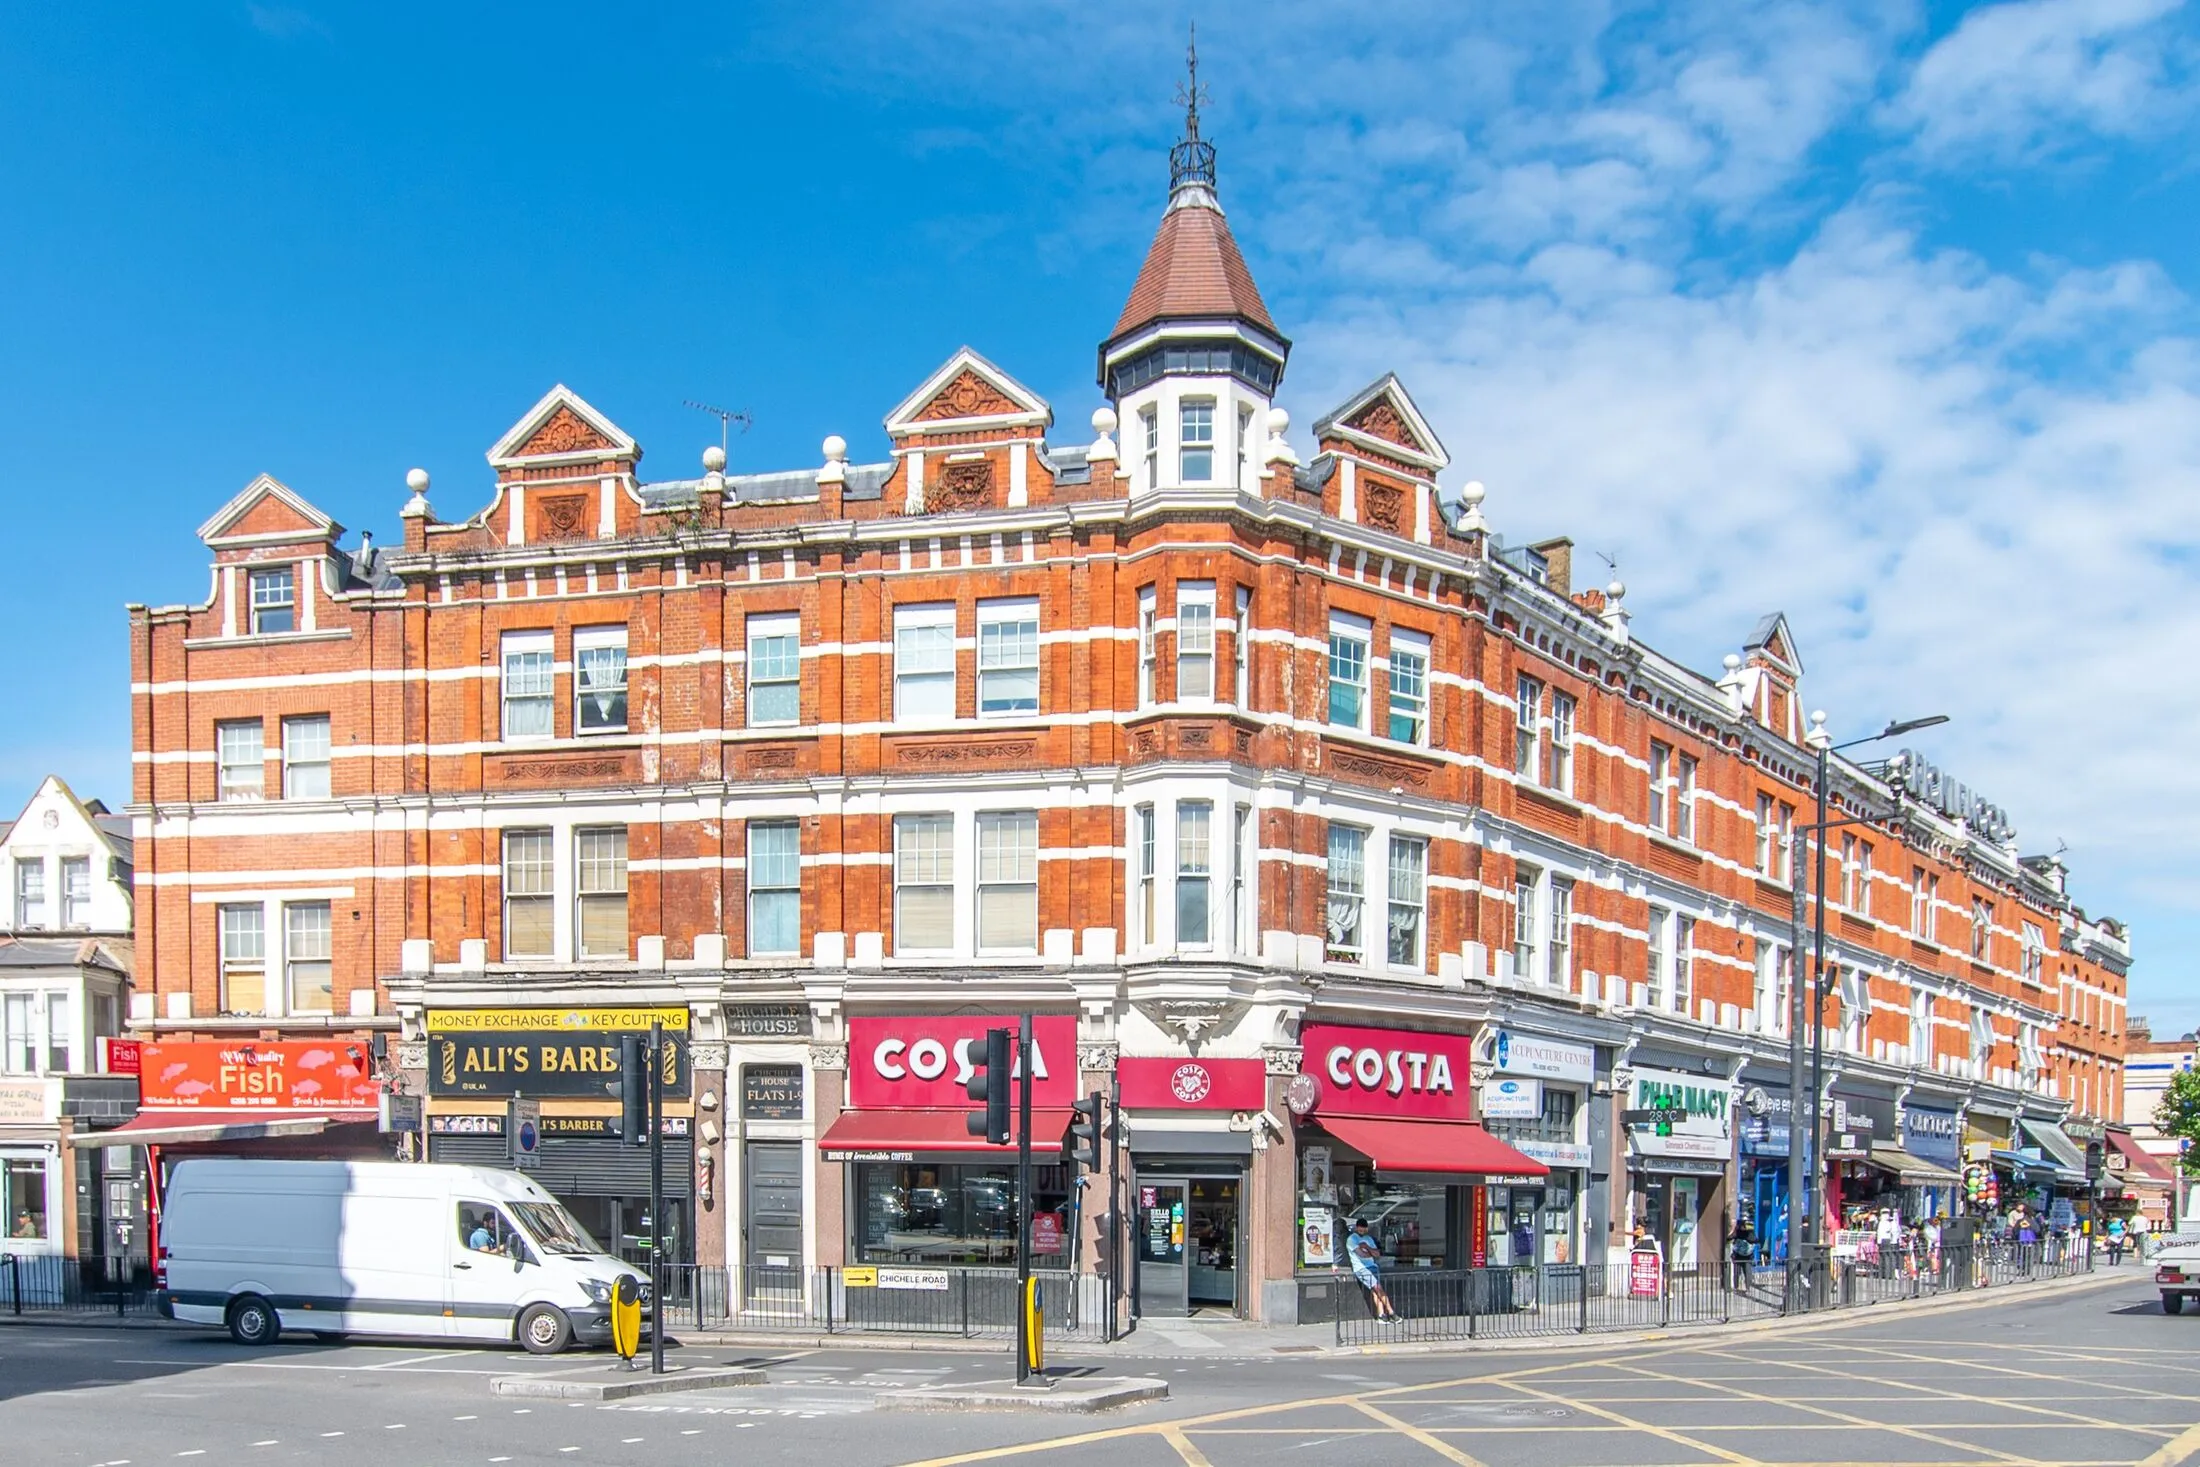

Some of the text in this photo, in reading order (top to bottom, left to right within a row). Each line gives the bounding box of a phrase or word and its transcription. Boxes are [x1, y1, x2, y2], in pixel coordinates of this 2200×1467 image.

[727, 1005, 799, 1018] CHICHELE
[432, 1013, 682, 1026] MONEY EXCHANGE KEY CUTTING
[740, 1019, 798, 1034] HOUSE
[112, 1046, 138, 1061] Fish
[246, 1050, 285, 1067] Quality
[463, 1046, 529, 1072] ALI'S
[1510, 1044, 1562, 1063] ACUPUNCTURE
[1564, 1053, 1591, 1067] CENTRE
[873, 1038, 1049, 1085] COSA
[1177, 1066, 1204, 1077] COSTA
[1326, 1044, 1454, 1094] COSTA
[220, 1065, 284, 1094] Fish
[760, 1078, 789, 1086] HOUSE
[747, 1089, 785, 1101] FLATS
[1175, 1087, 1207, 1101] COFFEE
[1649, 1111, 1663, 1121] 28
[559, 1119, 604, 1131] BARBER
[890, 1152, 913, 1161] COFFEE
[1828, 1147, 1868, 1156] HomeWare
[879, 1274, 946, 1284] CHICHELE ROAD
